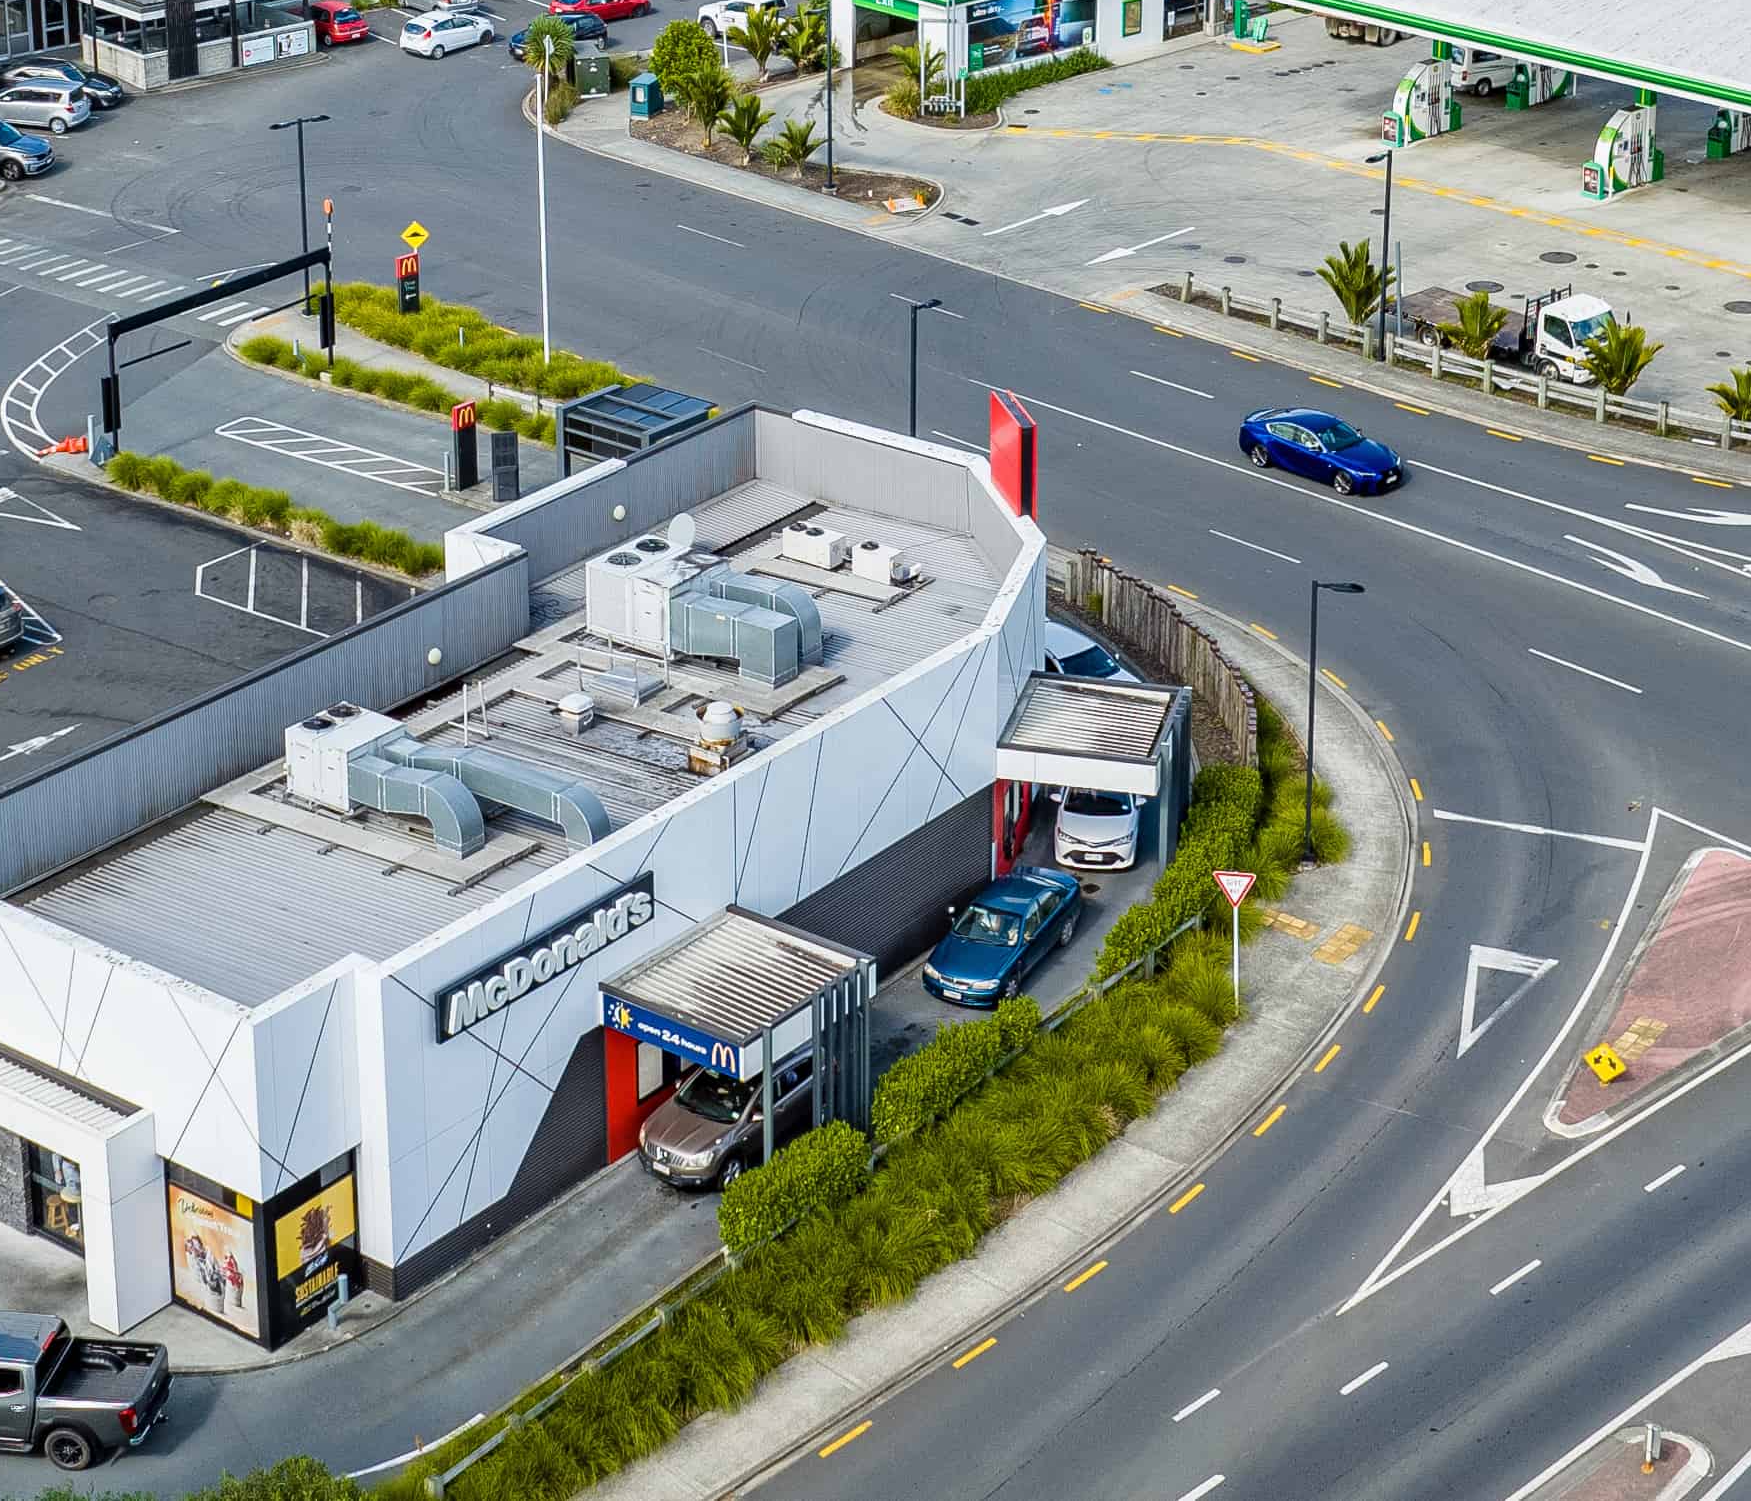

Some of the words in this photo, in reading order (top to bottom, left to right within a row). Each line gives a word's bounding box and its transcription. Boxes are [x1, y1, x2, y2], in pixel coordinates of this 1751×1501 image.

[447, 889, 653, 1036] McDonald's
[637, 1021, 661, 1037] open
[661, 1030, 681, 1046] 24
[680, 1038, 707, 1055] hours
